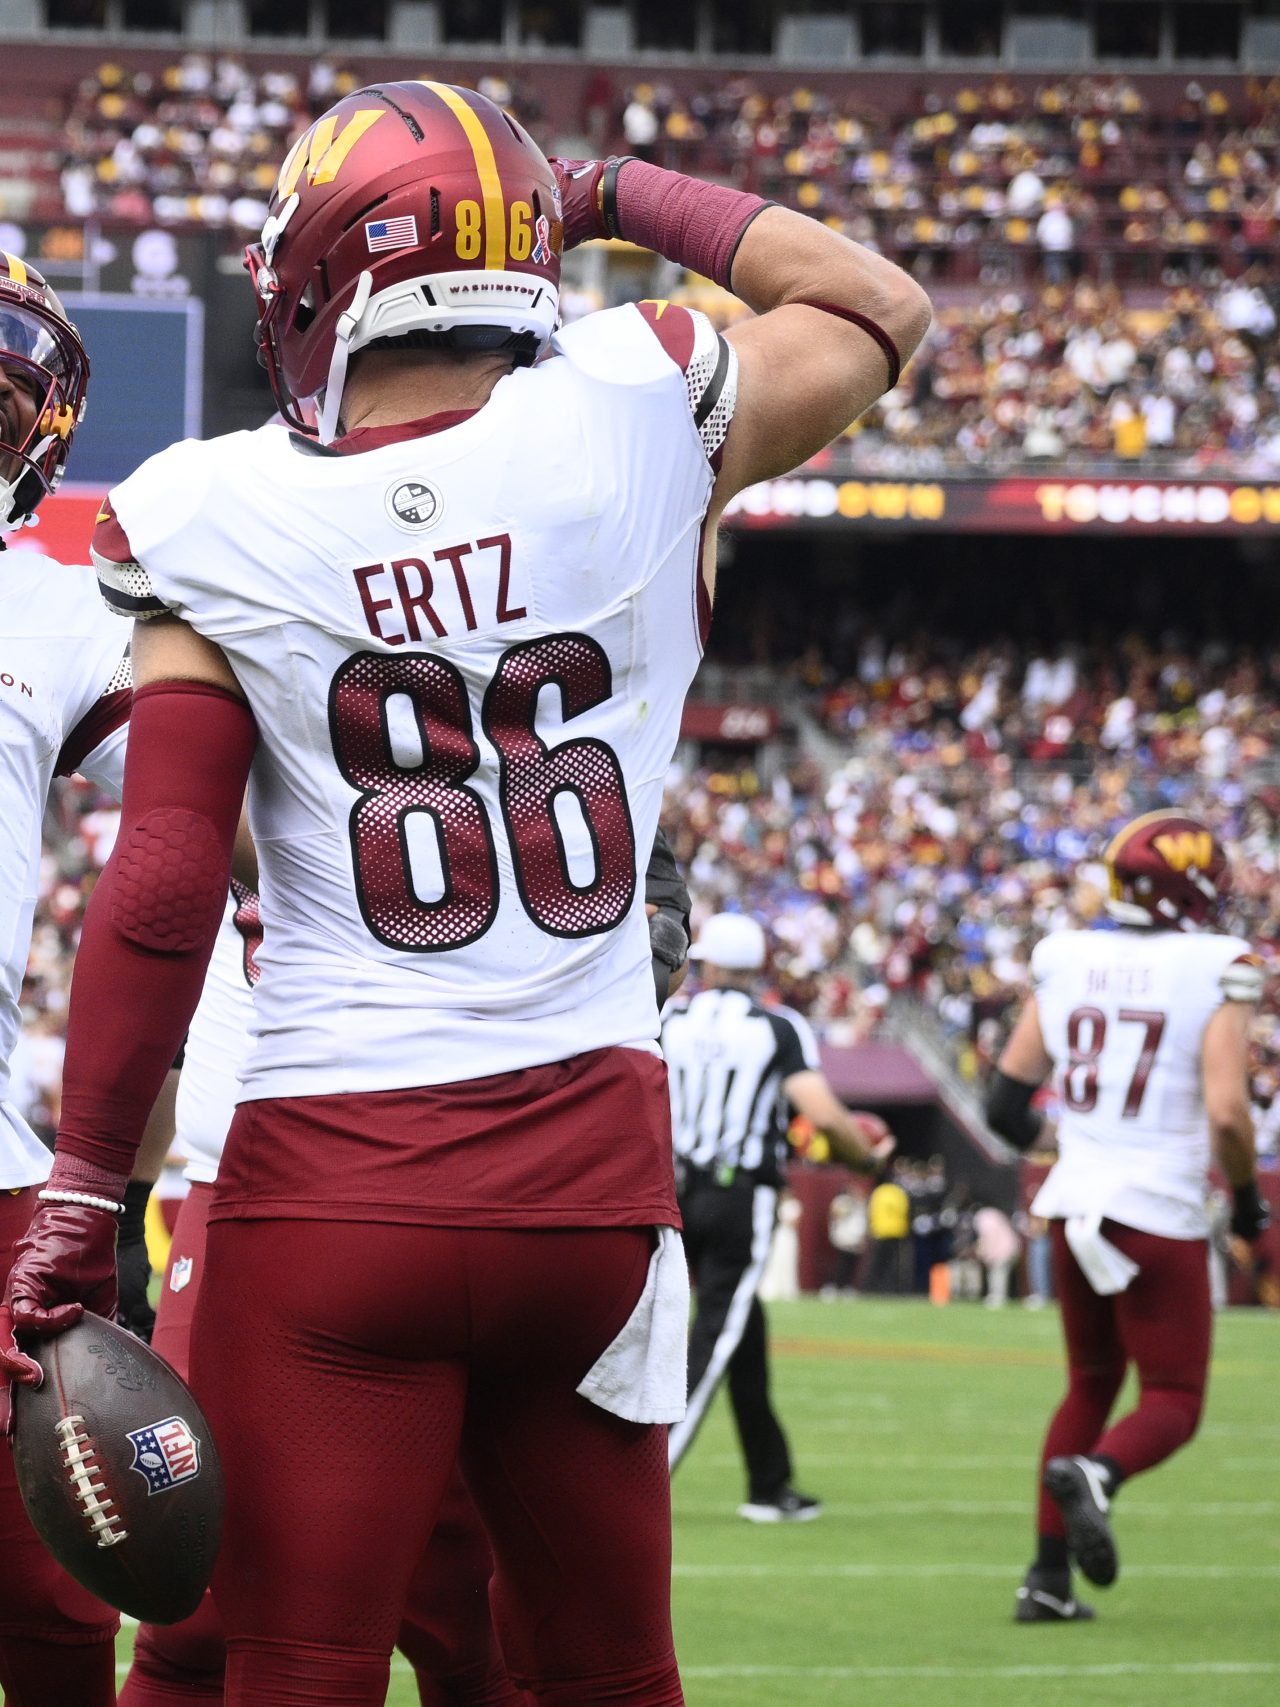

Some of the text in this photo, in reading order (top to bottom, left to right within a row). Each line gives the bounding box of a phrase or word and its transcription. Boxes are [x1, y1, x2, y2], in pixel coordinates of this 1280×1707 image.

[449, 284, 535, 296] WASHINGTON
[353, 533, 527, 646] ERTZ
[328, 632, 636, 953] 86
[1064, 1006, 1166, 1119] 87
[159, 1423, 196, 1478] NFL
